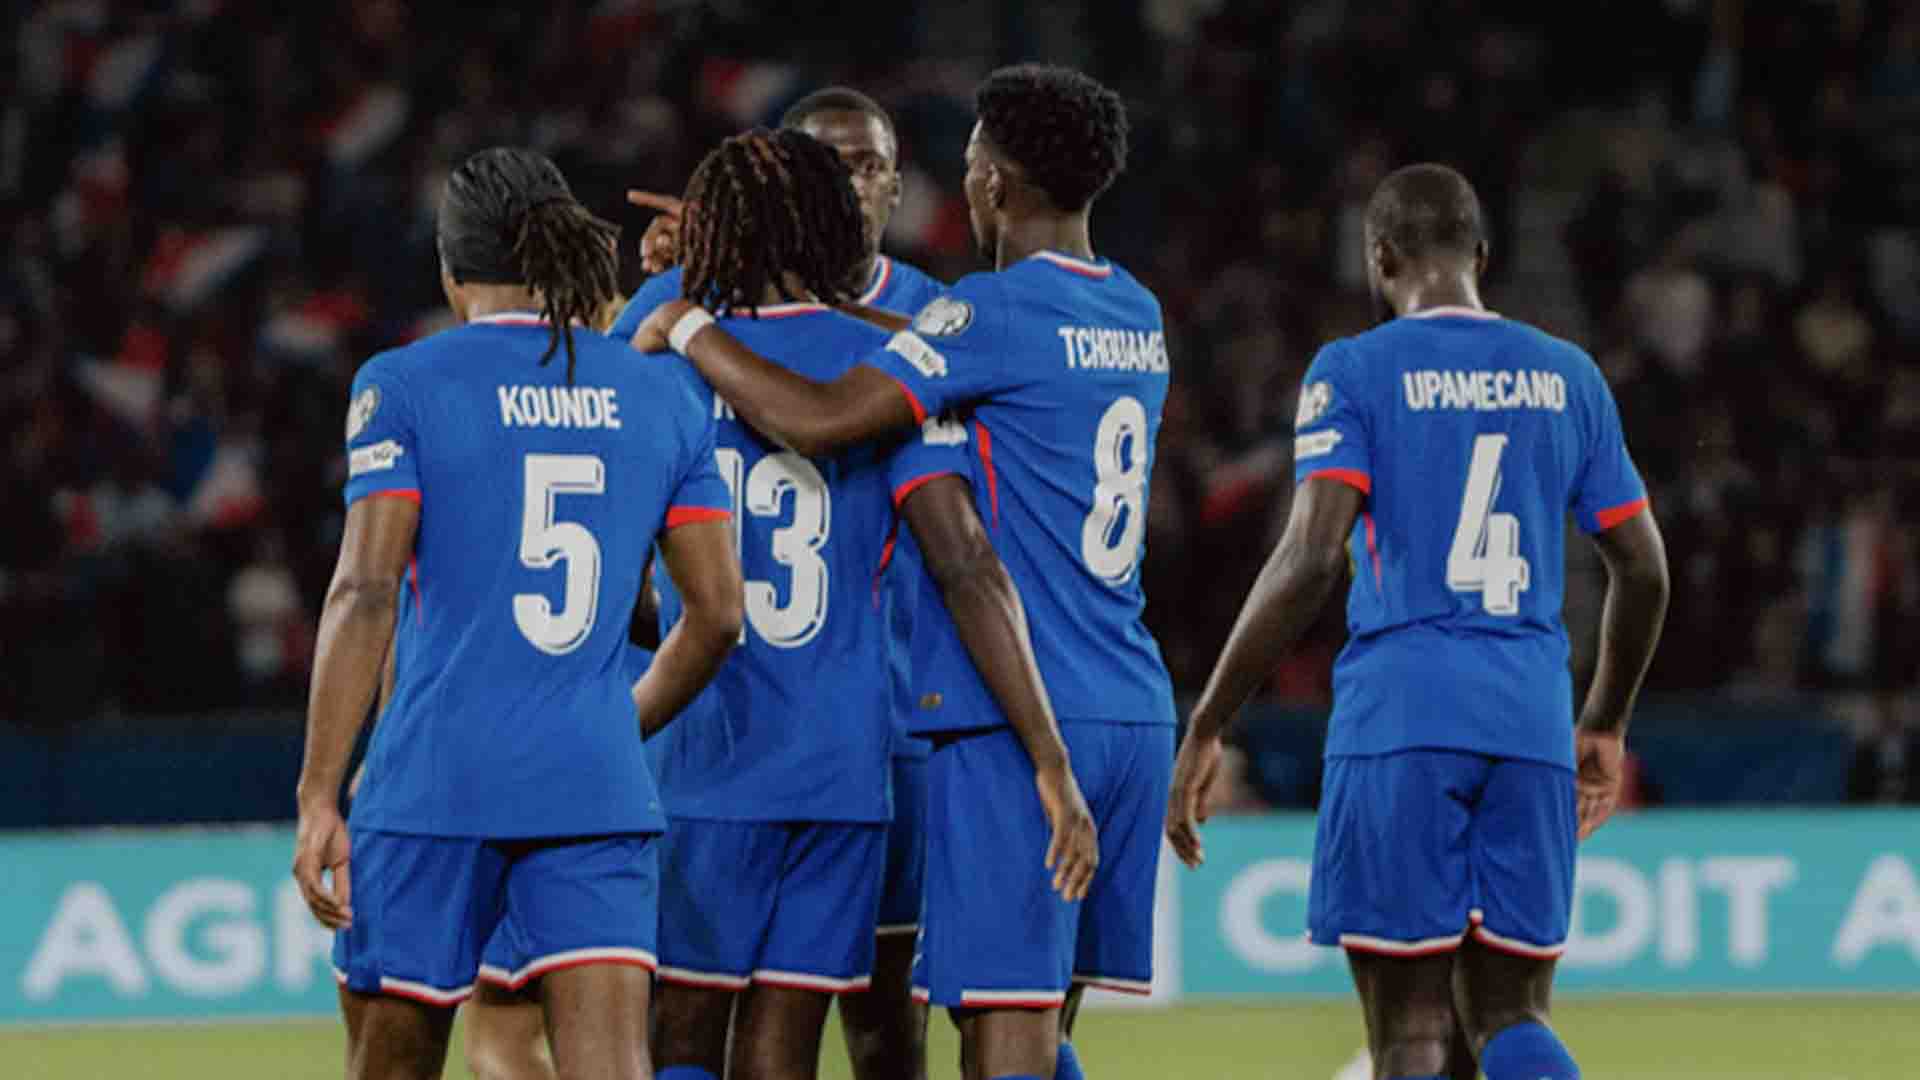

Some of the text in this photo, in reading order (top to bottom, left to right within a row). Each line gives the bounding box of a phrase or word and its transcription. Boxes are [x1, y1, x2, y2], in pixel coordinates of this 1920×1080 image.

[496, 384, 621, 428] KOUNDE
[1402, 370, 1567, 416] UPAMECANO
[513, 454, 605, 656] 5
[1082, 396, 1147, 589] 8
[1446, 433, 1530, 616] 4
[1219, 855, 1796, 972] CDIT
